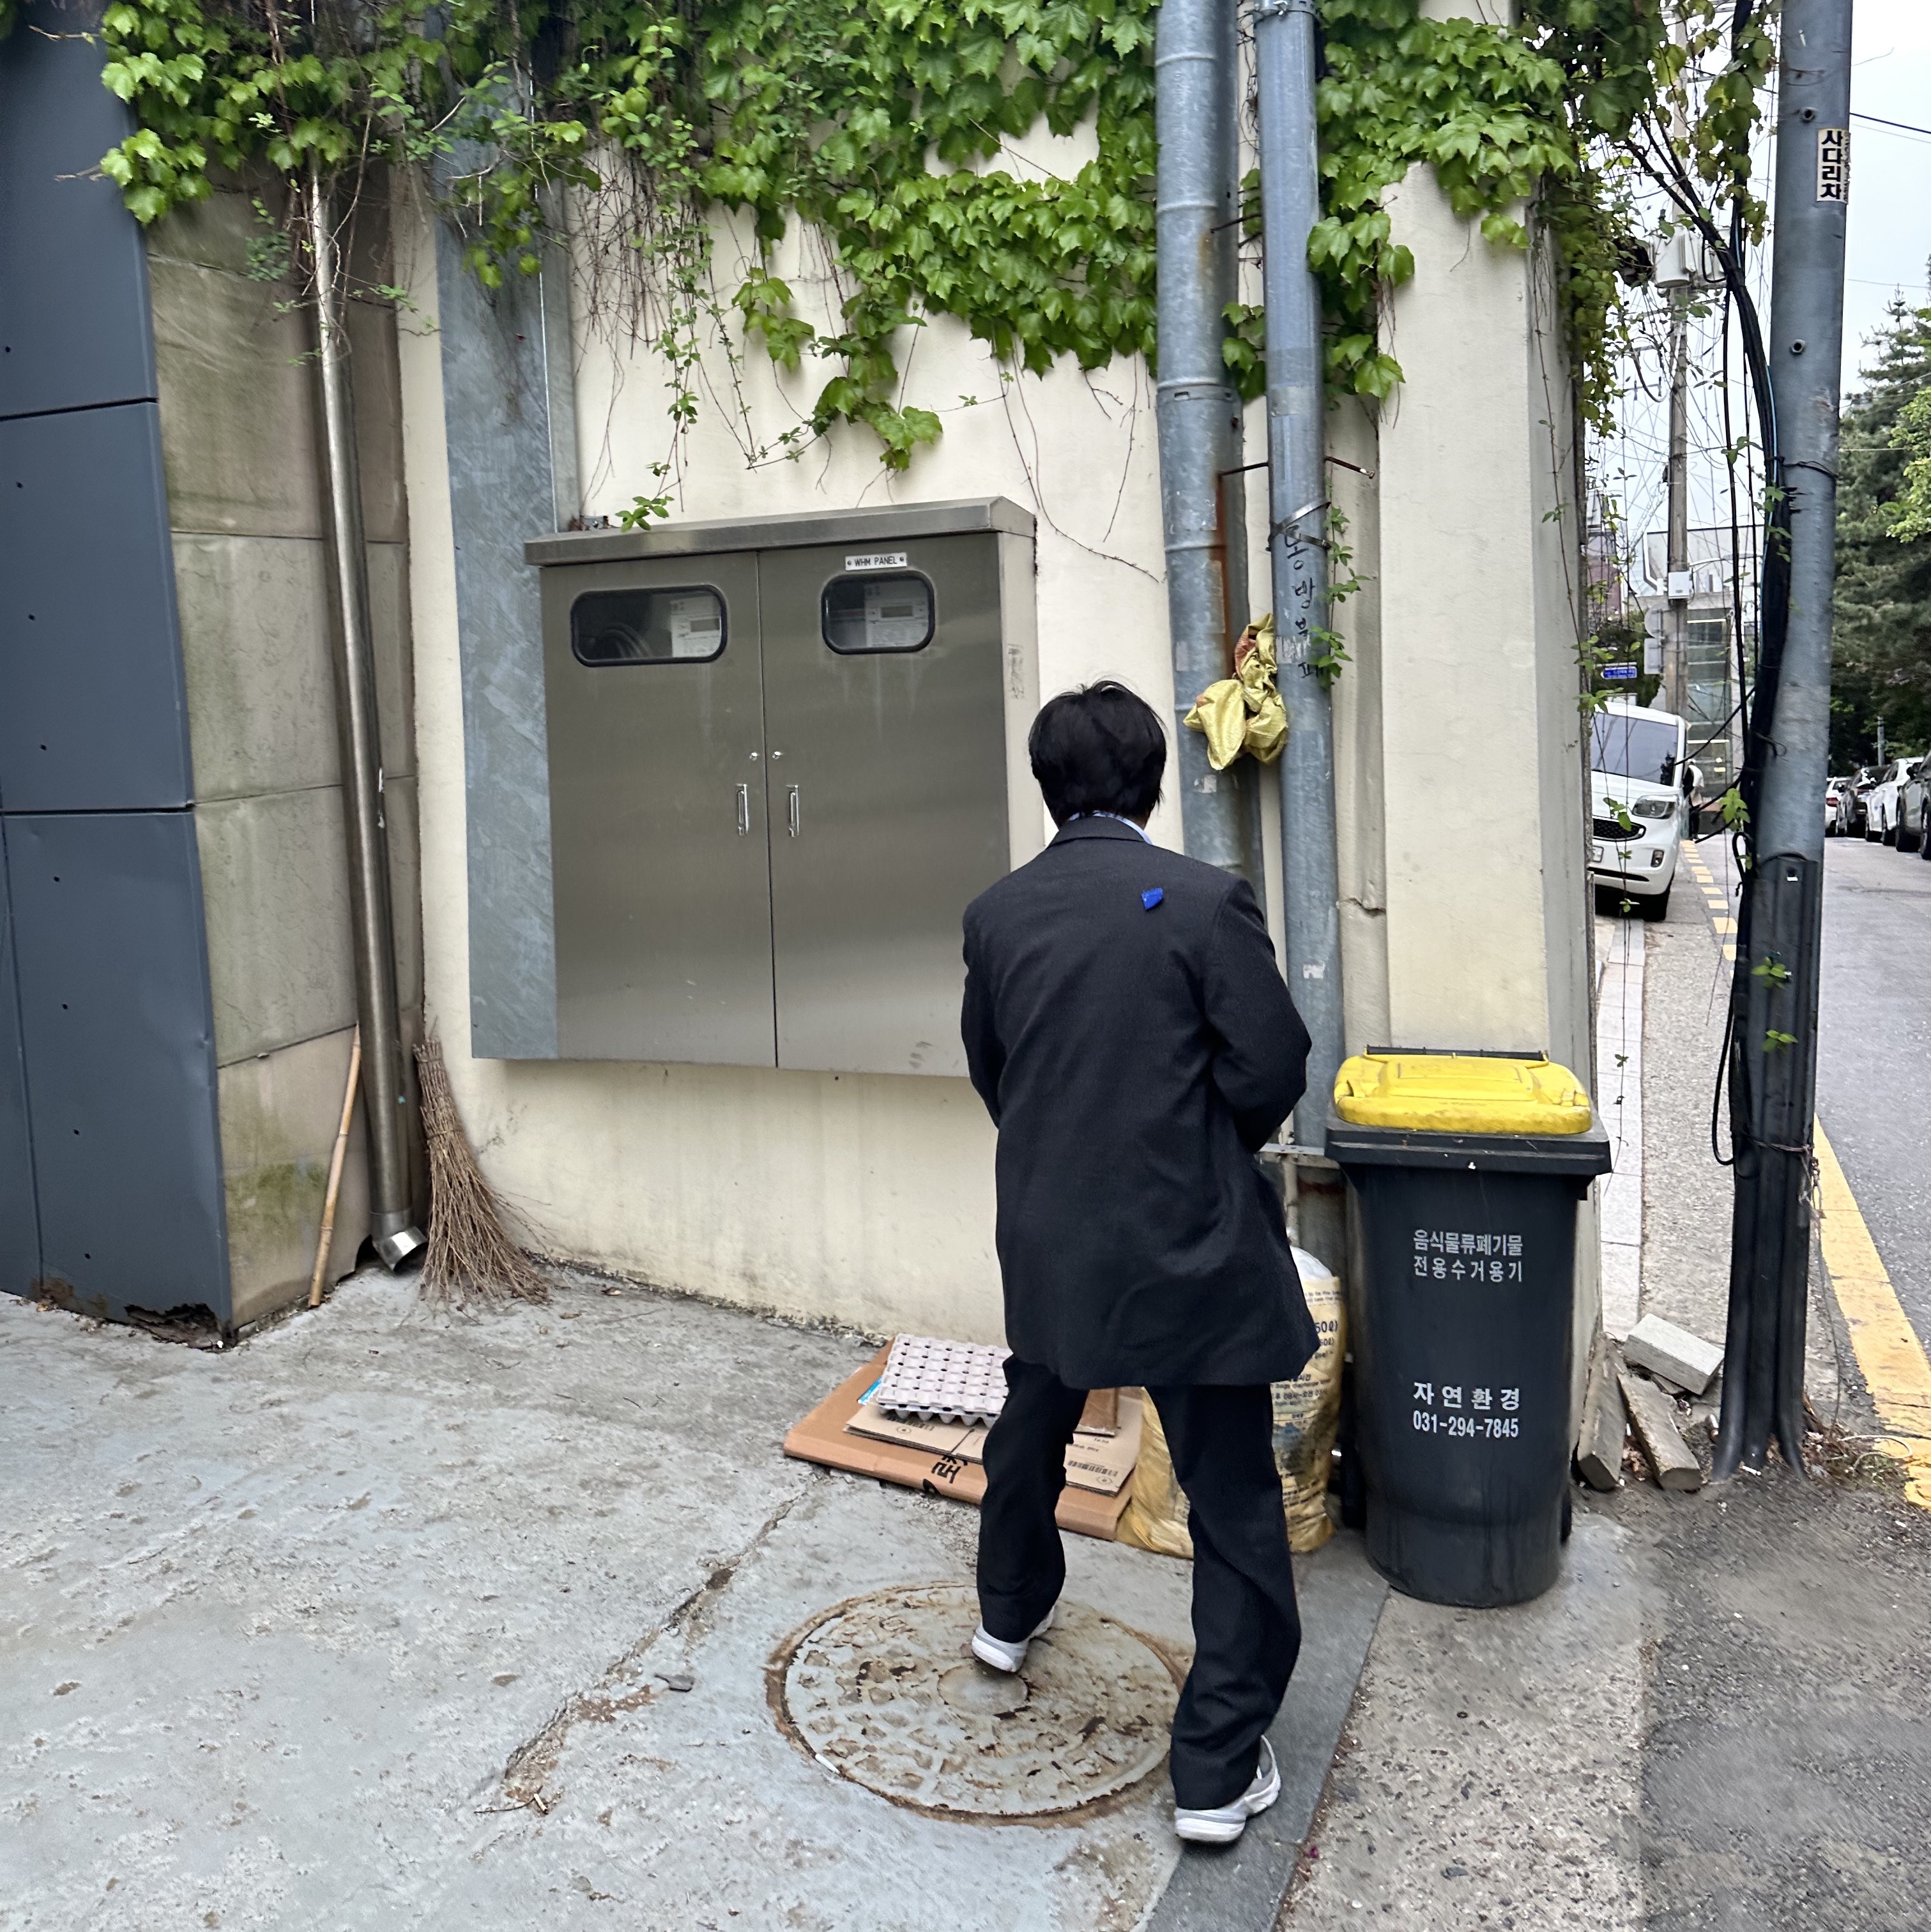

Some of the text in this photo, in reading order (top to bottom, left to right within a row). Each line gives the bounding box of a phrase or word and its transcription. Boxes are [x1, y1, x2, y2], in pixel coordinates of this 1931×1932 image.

[1820, 130, 1843, 200] 사다리차
[854, 556, 897, 567] WHM PANEL
[1413, 1229, 1523, 1256] 음식물류폐기물
[1413, 1410, 1519, 1438] 031-294-7845
